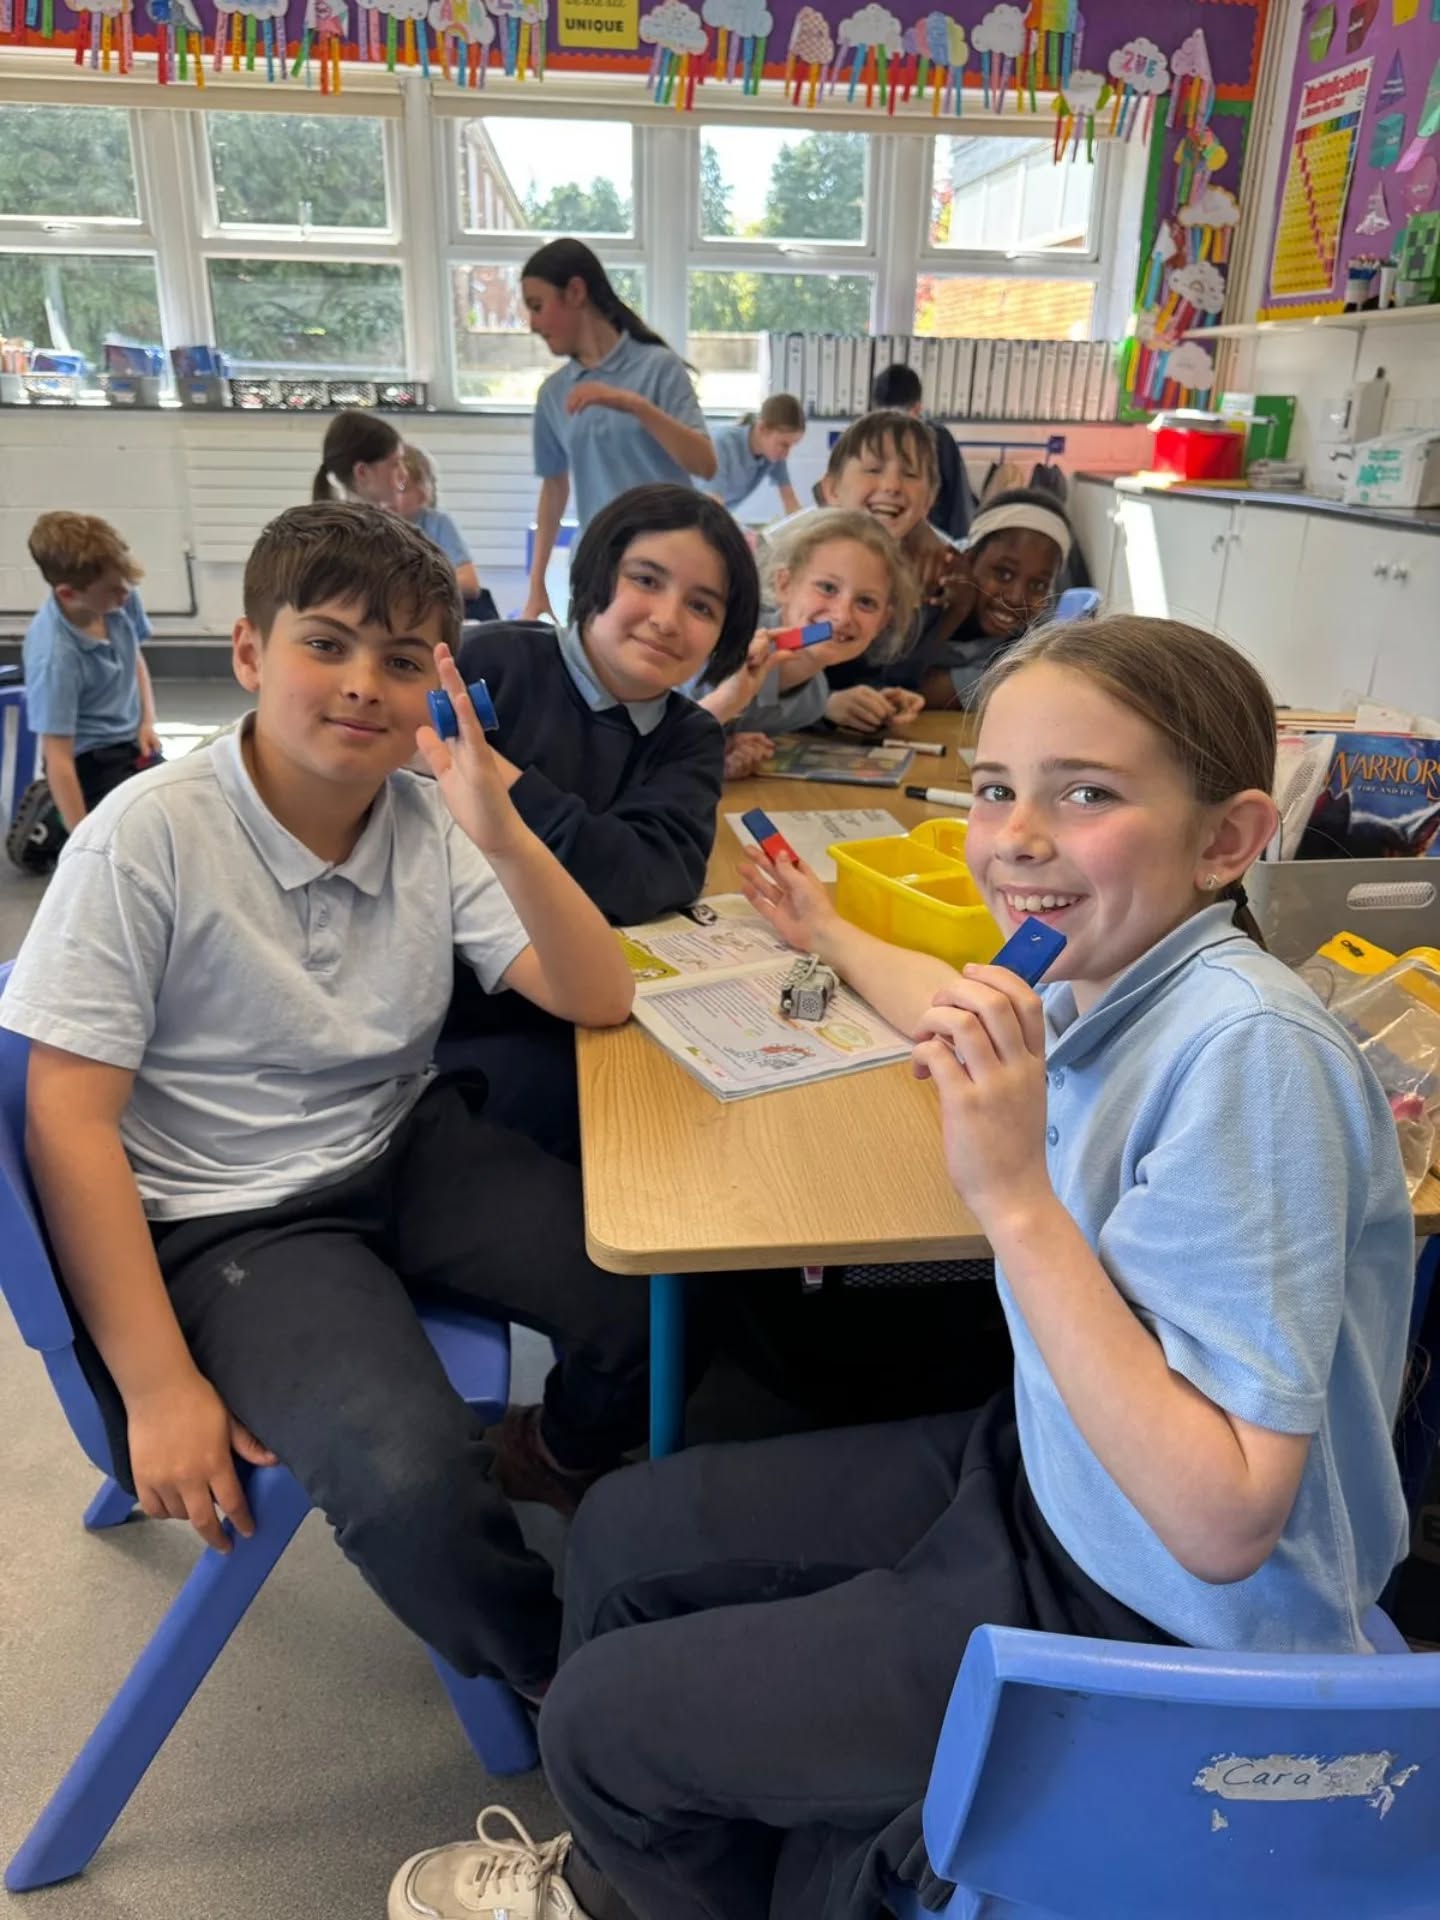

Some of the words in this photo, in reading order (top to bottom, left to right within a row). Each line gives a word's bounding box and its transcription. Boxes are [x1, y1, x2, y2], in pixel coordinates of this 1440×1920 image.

[565, 18, 625, 34] UNIQUE
[1323, 751, 1440, 800] WARRIOR
[1222, 1763, 1311, 1786] Cara
